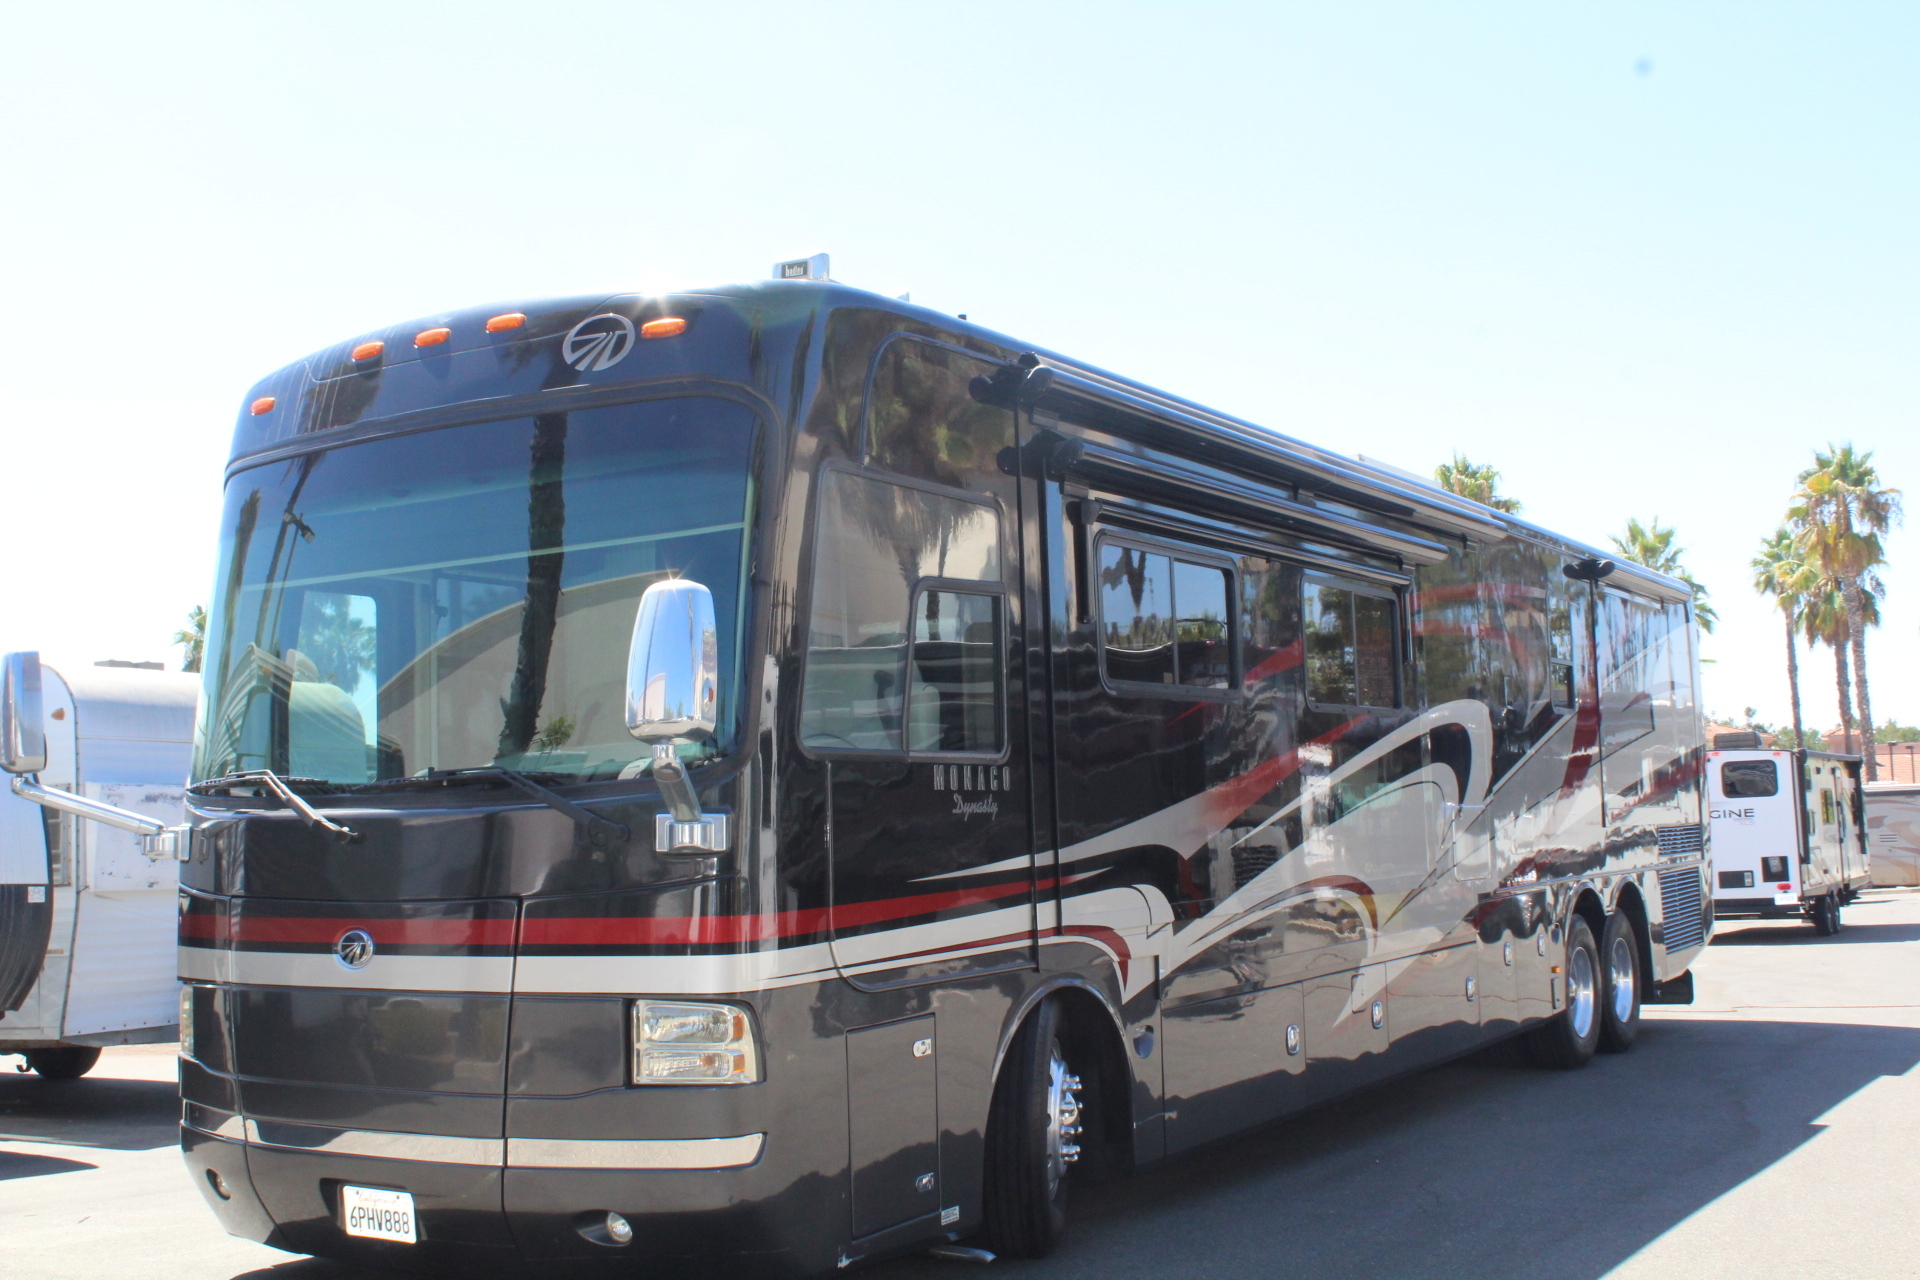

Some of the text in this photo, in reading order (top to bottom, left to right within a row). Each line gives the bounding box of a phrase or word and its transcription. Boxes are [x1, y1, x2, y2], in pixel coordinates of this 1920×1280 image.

[933, 764, 1011, 791] MONACO
[952, 793, 998, 821] Dynasty
[350, 1206, 410, 1235] 6PHV888
